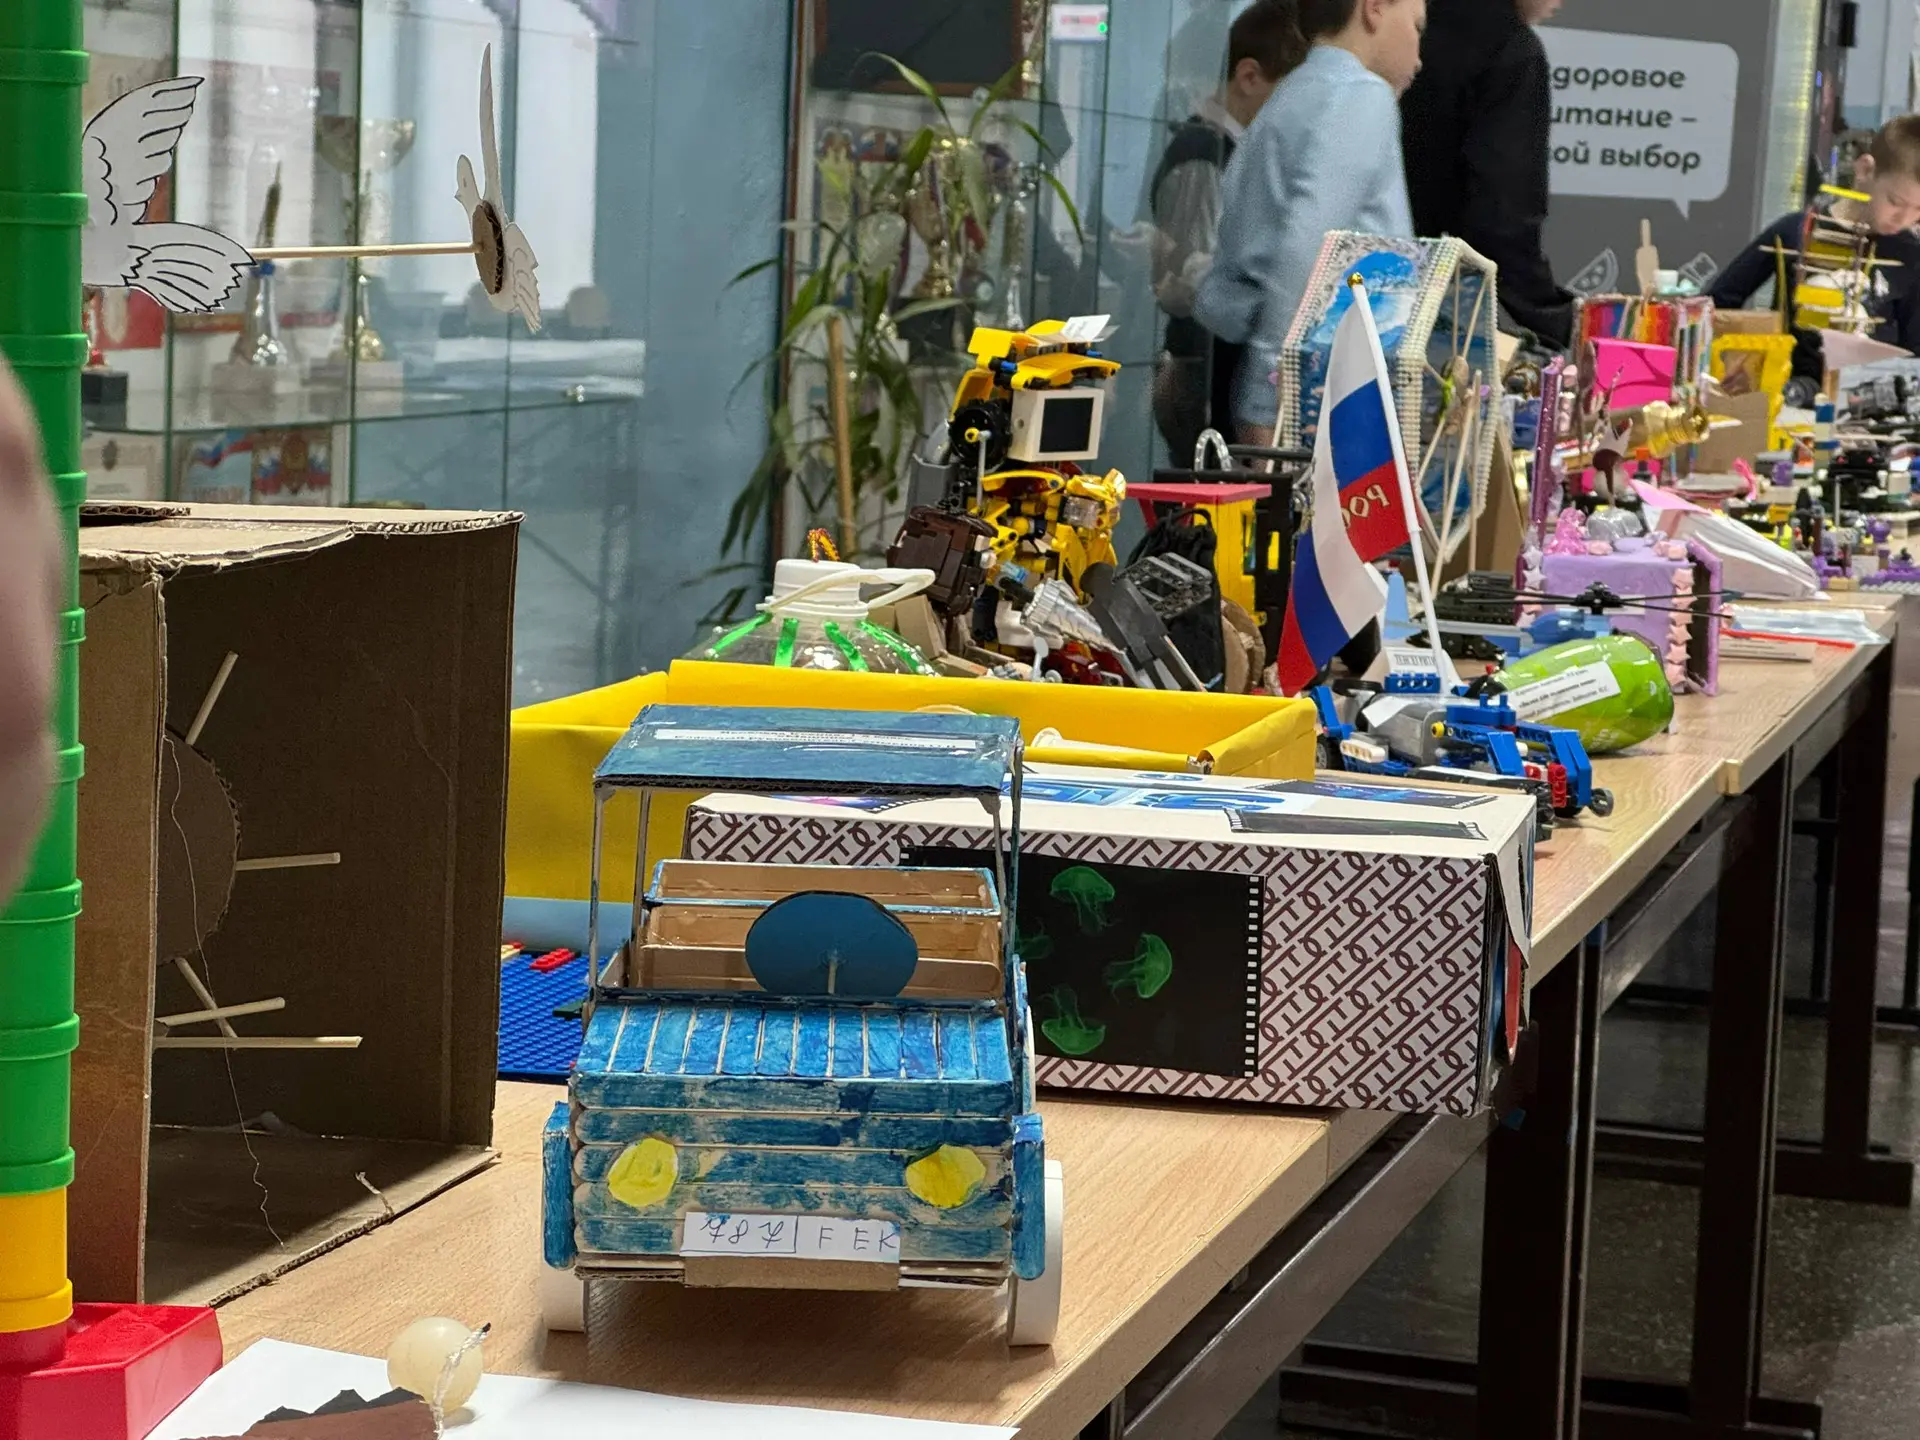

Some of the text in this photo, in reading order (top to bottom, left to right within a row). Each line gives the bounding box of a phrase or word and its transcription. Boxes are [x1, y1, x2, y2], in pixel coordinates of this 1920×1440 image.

[1550, 66, 1687, 91] доровое
[1549, 105, 1673, 128] итание
[1550, 141, 1701, 175] ой выбор
